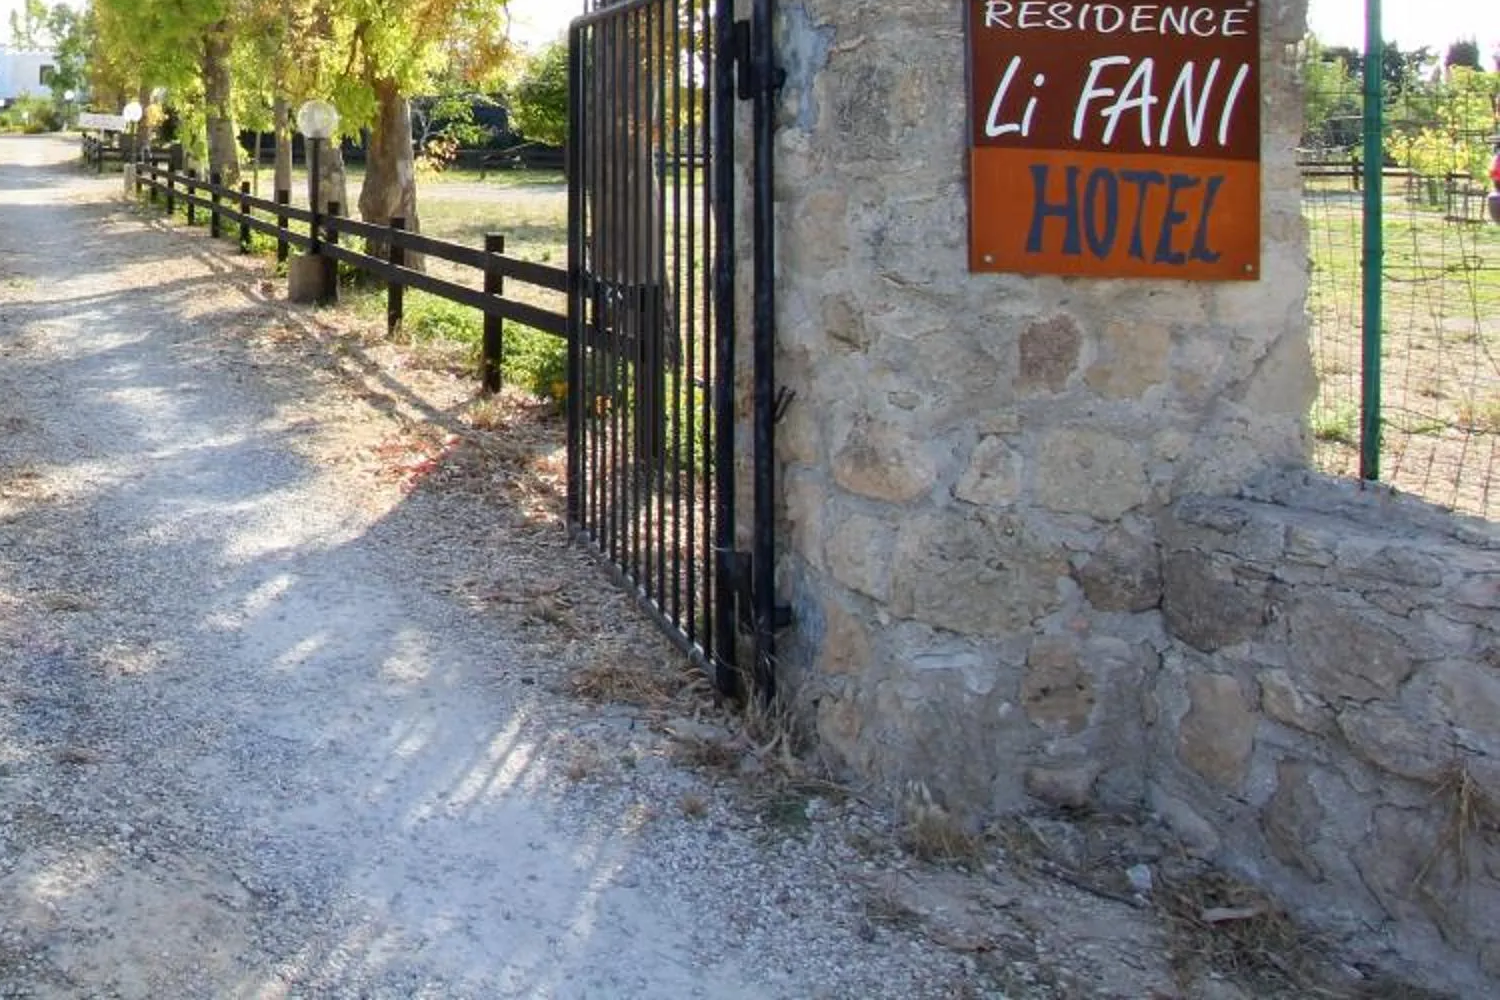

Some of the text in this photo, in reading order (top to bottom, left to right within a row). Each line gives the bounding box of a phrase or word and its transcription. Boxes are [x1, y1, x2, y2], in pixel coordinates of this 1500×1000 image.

[985, 0, 1249, 36] RESIDENCE
[985, 55, 1249, 147] Li FANI
[1025, 164, 1224, 265] HOTEL
